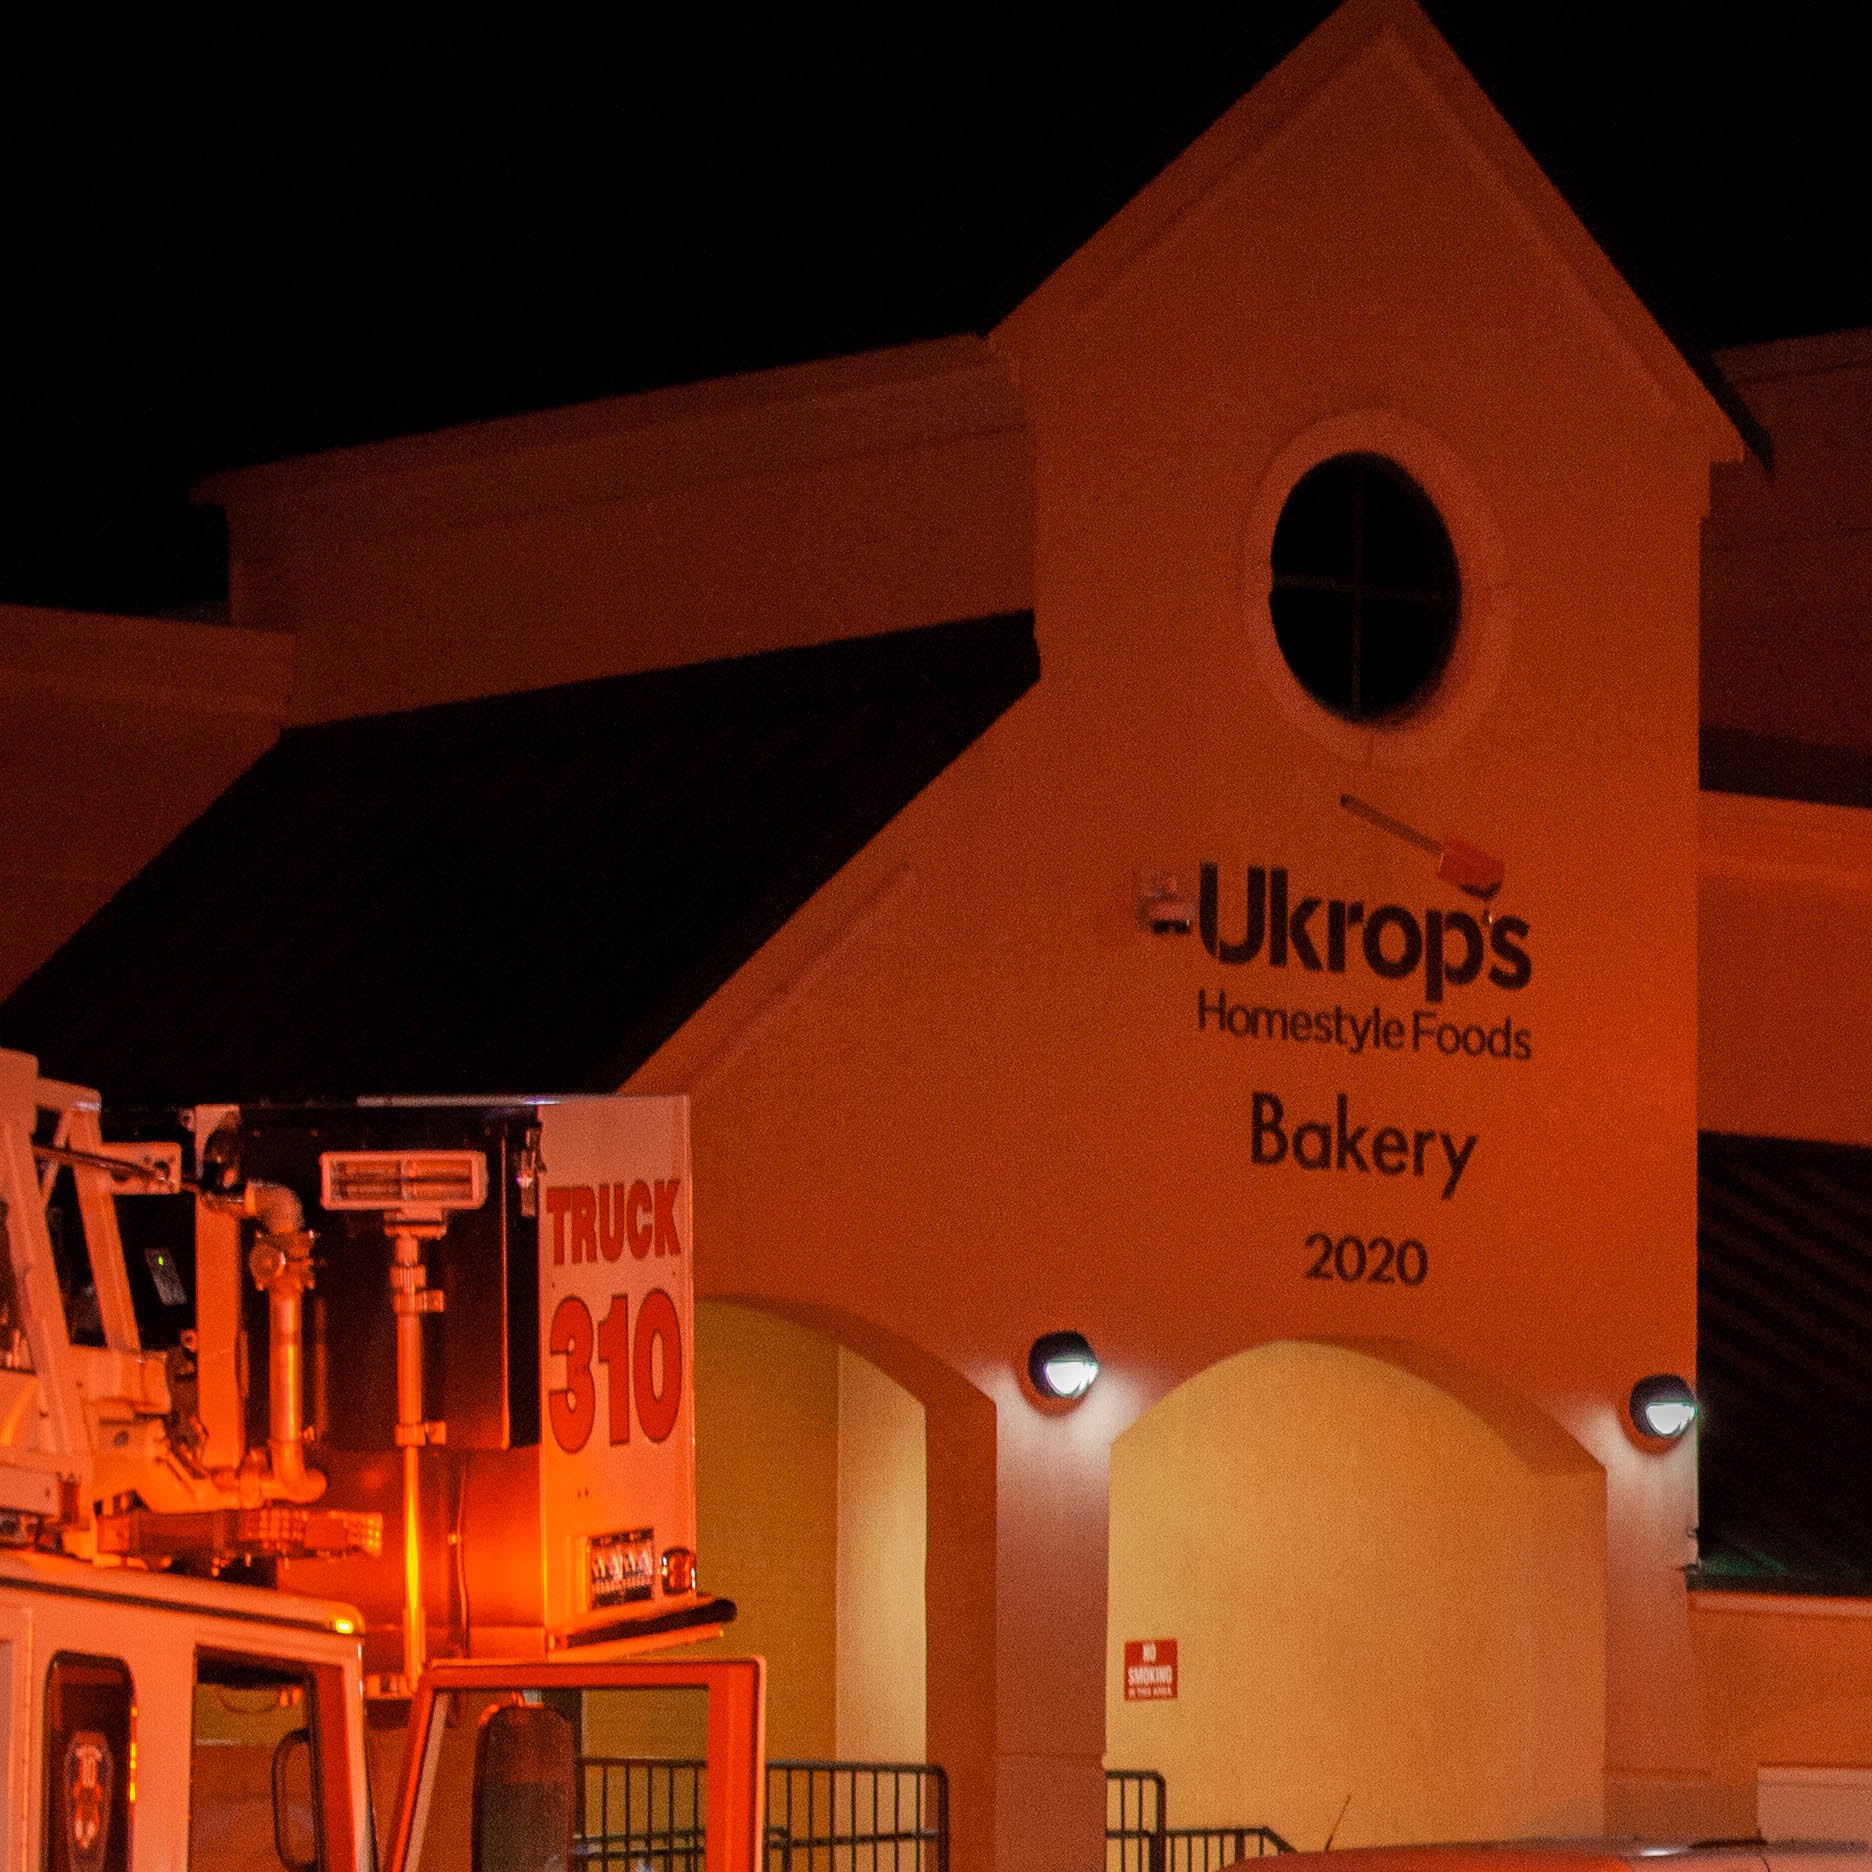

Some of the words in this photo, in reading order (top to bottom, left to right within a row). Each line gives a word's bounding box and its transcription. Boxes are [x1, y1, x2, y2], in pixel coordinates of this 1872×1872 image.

[1198, 988, 1405, 1054] Homestyle
[1411, 1009, 1533, 1061] Foods
[1250, 1091, 1479, 1201] Bakery
[546, 1178, 682, 1267] TRUCK
[1303, 1232, 1429, 1286] 2020
[548, 1287, 683, 1454] 310
[1128, 1665, 1172, 1686] SMOKING
[1142, 1642, 1156, 1662] NO
